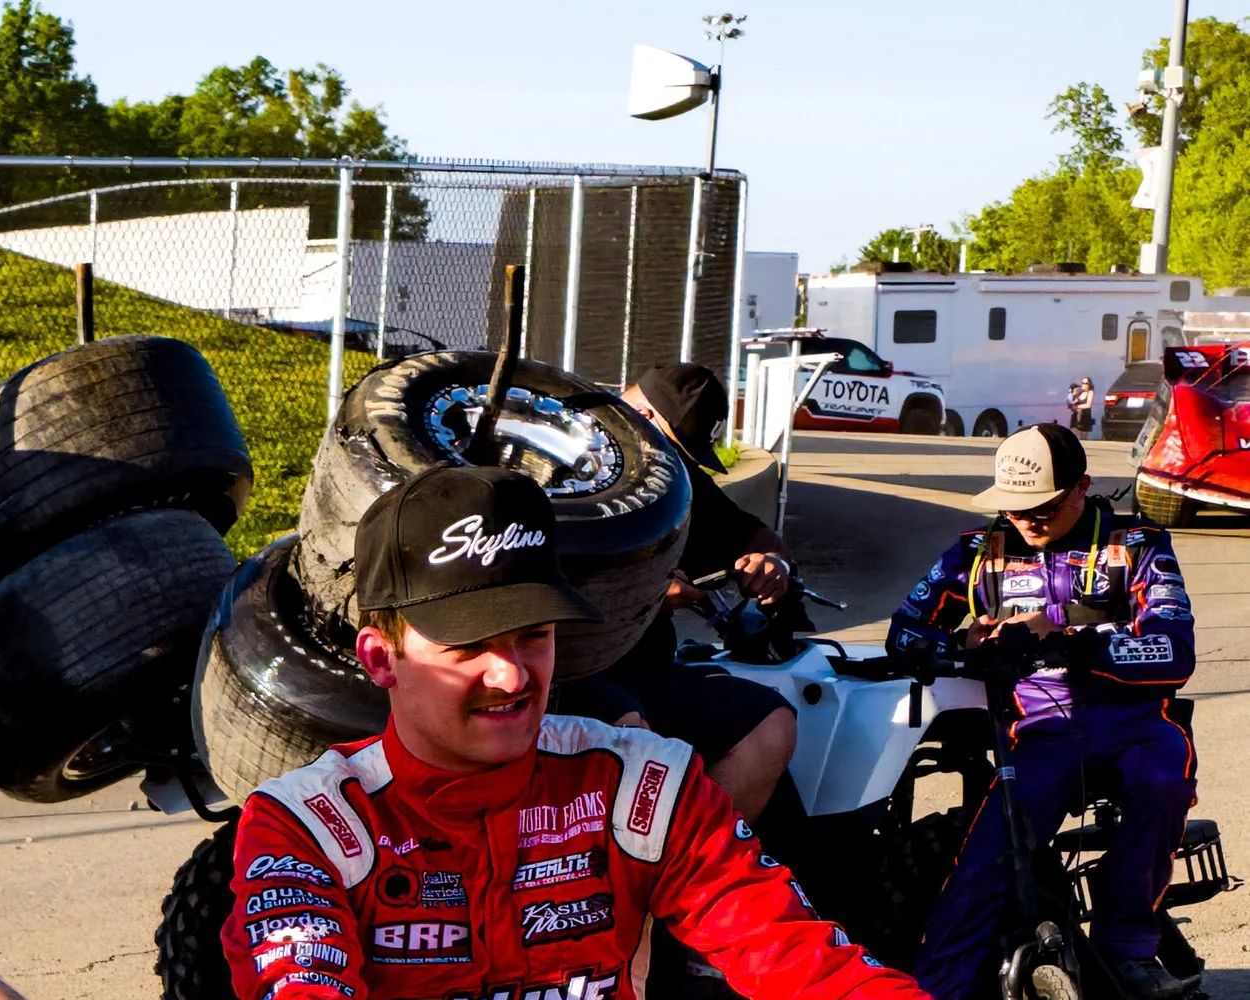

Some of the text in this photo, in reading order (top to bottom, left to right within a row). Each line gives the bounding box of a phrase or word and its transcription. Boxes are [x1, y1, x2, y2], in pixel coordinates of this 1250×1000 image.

[823, 379, 890, 405] TOYOTA
[428, 515, 546, 566] Skyline
[1010, 578, 1032, 588] DCE
[1126, 646, 1169, 654] ROD
[563, 791, 606, 828] FARMS
[632, 765, 664, 830] SIMPSON
[310, 799, 358, 851] SIMPSON
[246, 856, 332, 882] Olson
[514, 852, 592, 882] STEALTH
[523, 901, 589, 925] KASH
[525, 908, 609, 939] MONEY
[374, 923, 469, 950] BRP
[296, 941, 348, 967] COUNTRY
